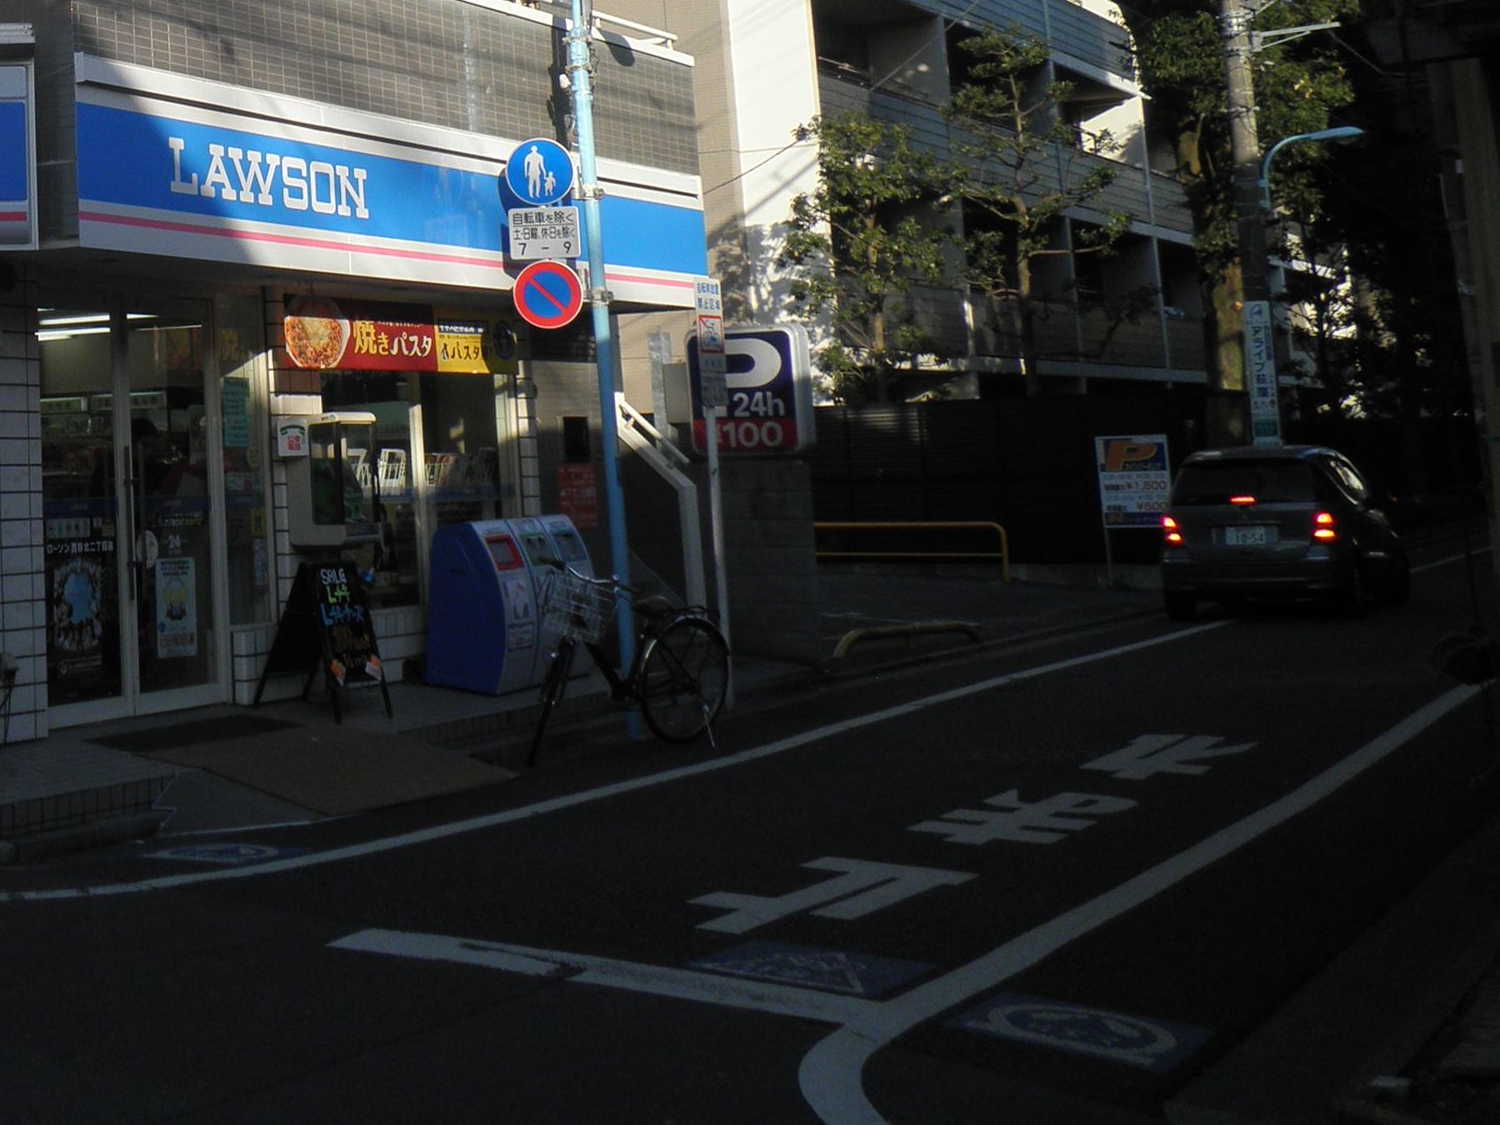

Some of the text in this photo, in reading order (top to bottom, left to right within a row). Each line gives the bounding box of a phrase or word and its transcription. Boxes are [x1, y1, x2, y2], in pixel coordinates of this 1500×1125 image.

[168, 136, 371, 221] LAWSON
[512, 211, 575, 226] 自転車を除く
[518, 242, 527, 256] 7
[563, 241, 572, 254] 9
[353, 319, 432, 358] 焼きパスタ
[732, 391, 785, 418] 24h
[718, 421, 783, 448] 100
[1107, 440, 1157, 472] P
